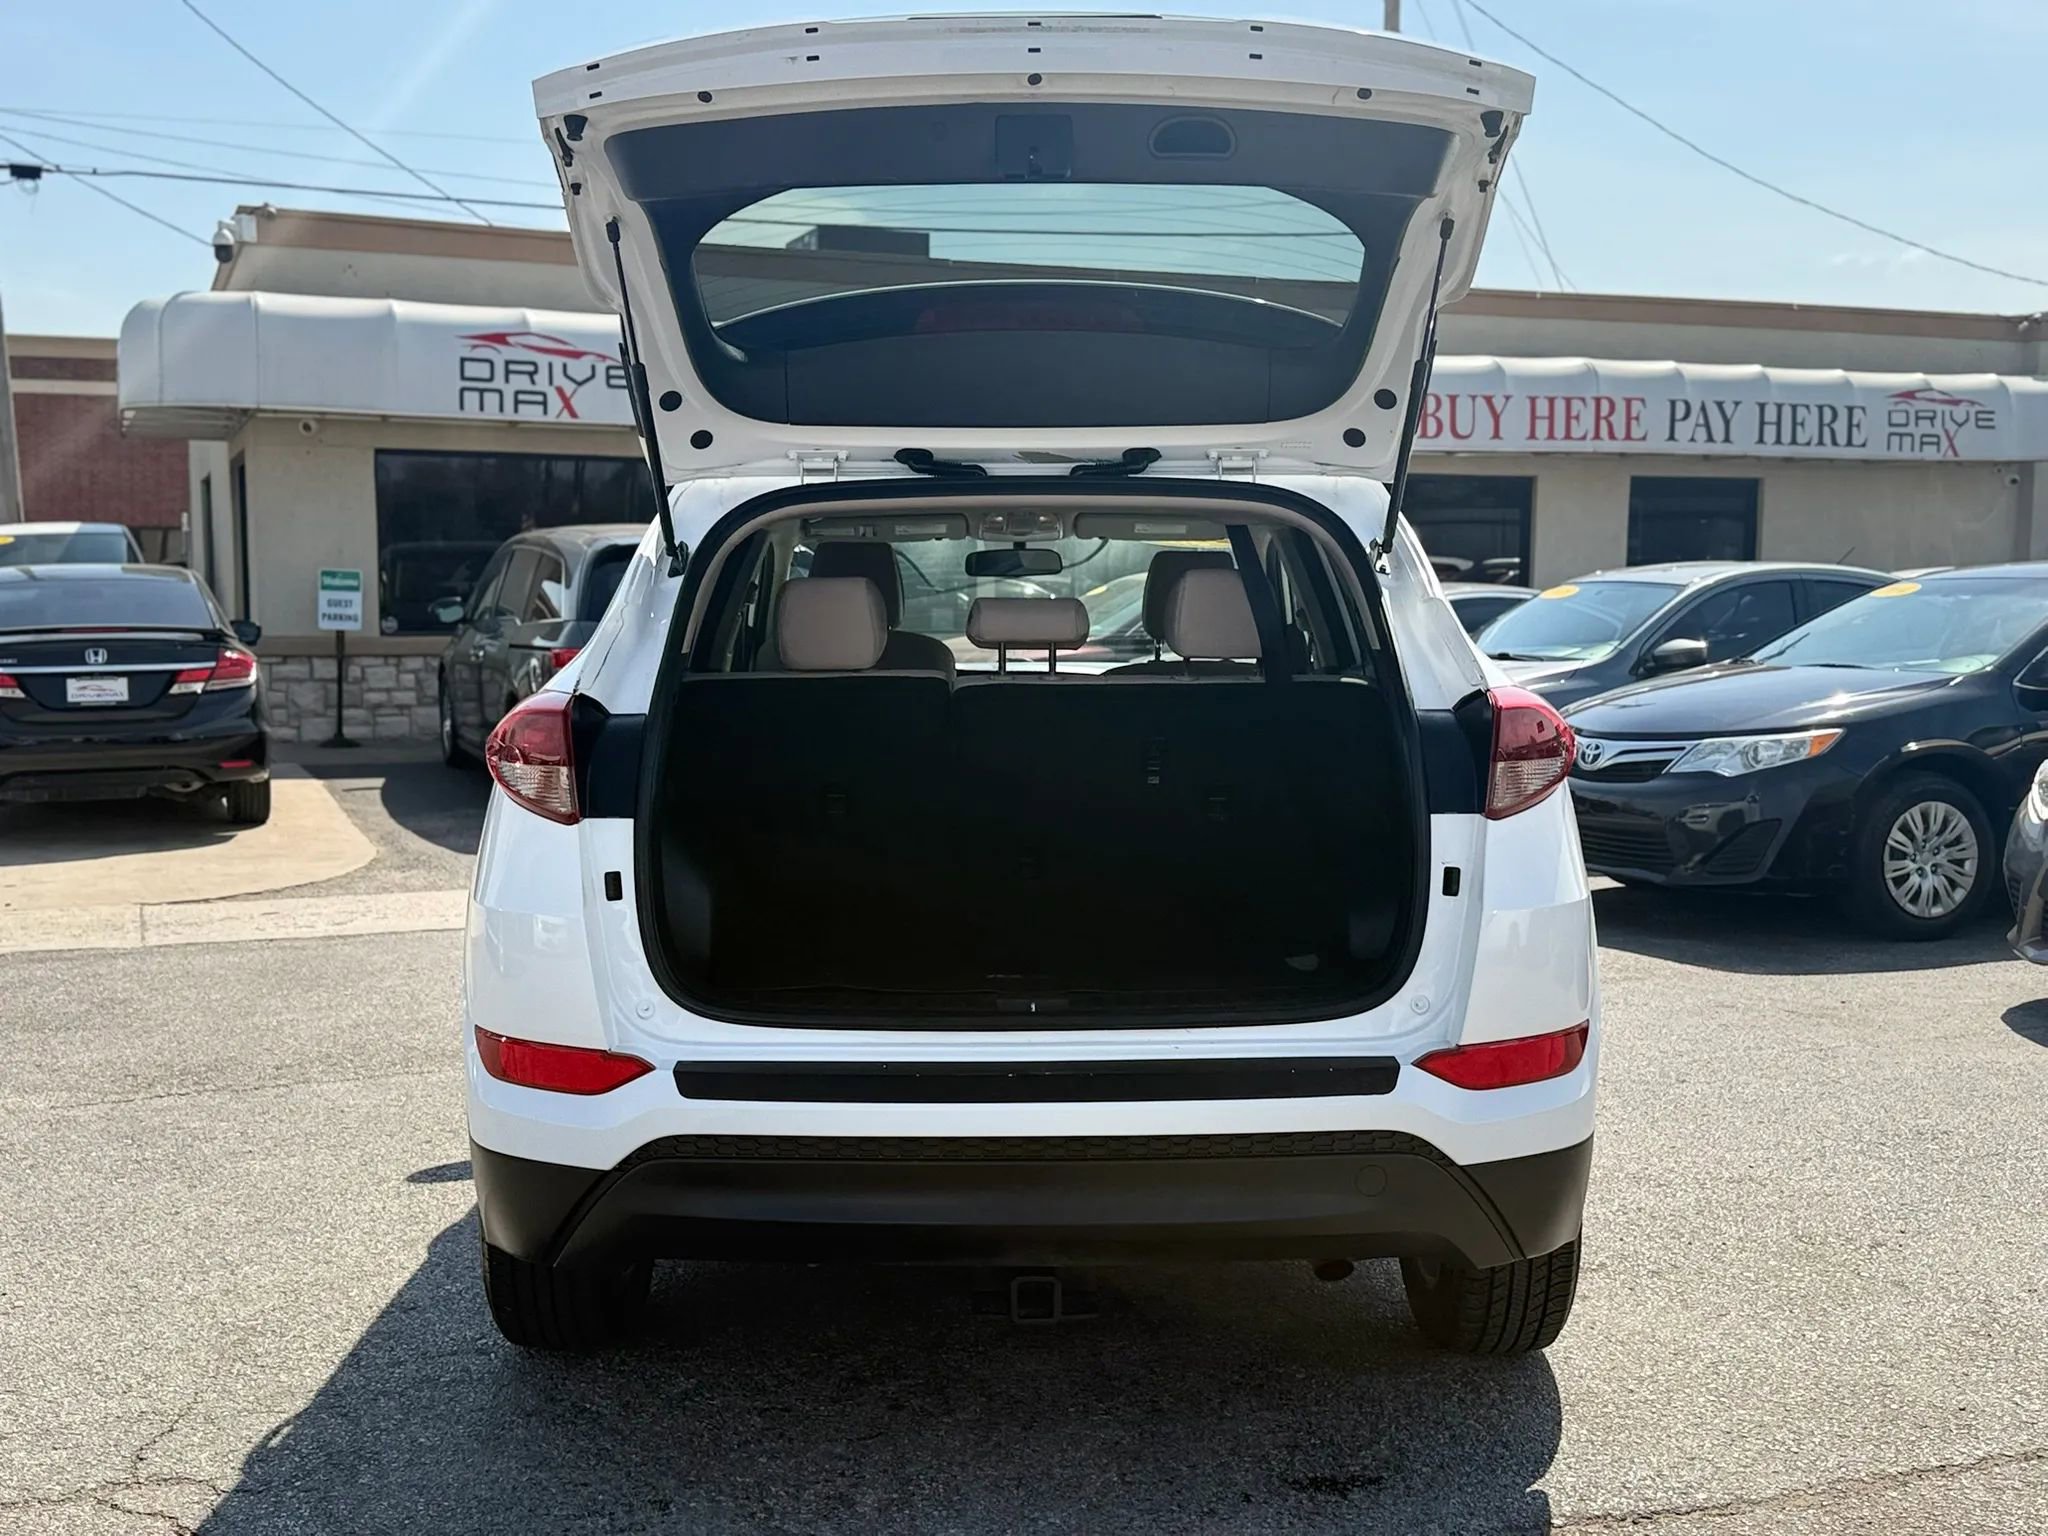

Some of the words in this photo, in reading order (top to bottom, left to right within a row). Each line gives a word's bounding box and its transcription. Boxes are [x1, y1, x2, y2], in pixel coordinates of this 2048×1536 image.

[459, 356, 628, 389] DRIVE
[459, 385, 579, 419] MAX
[1417, 393, 1514, 441] BUY
[1525, 395, 1649, 442] HERE
[1664, 398, 1743, 445] PAY
[1754, 401, 1869, 449] HERE
[1887, 409, 1996, 430] DRIVE
[1886, 429, 1960, 458] MAX
[321, 612, 359, 623] PARKING
[327, 598, 353, 608] GUEST
